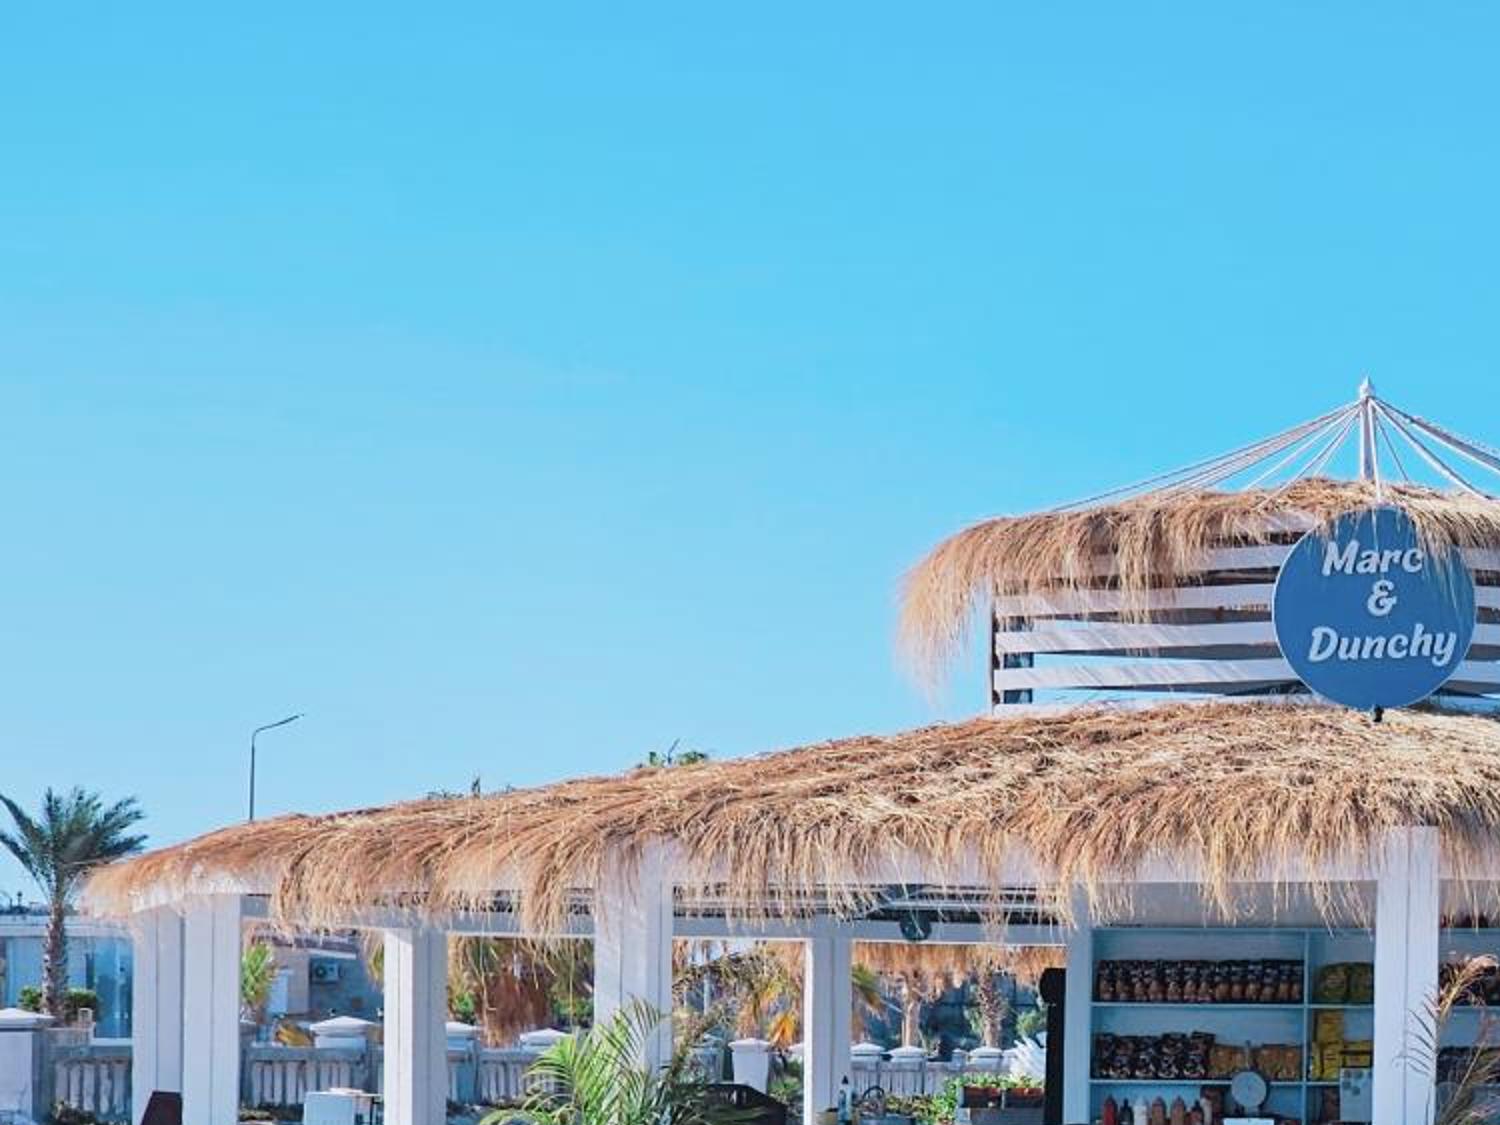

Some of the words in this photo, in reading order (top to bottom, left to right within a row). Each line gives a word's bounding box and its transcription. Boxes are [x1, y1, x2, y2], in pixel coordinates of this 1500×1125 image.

[1322, 540, 1423, 576] Marc
[1367, 579, 1397, 616] &
[1309, 624, 1457, 668] Dunchy
